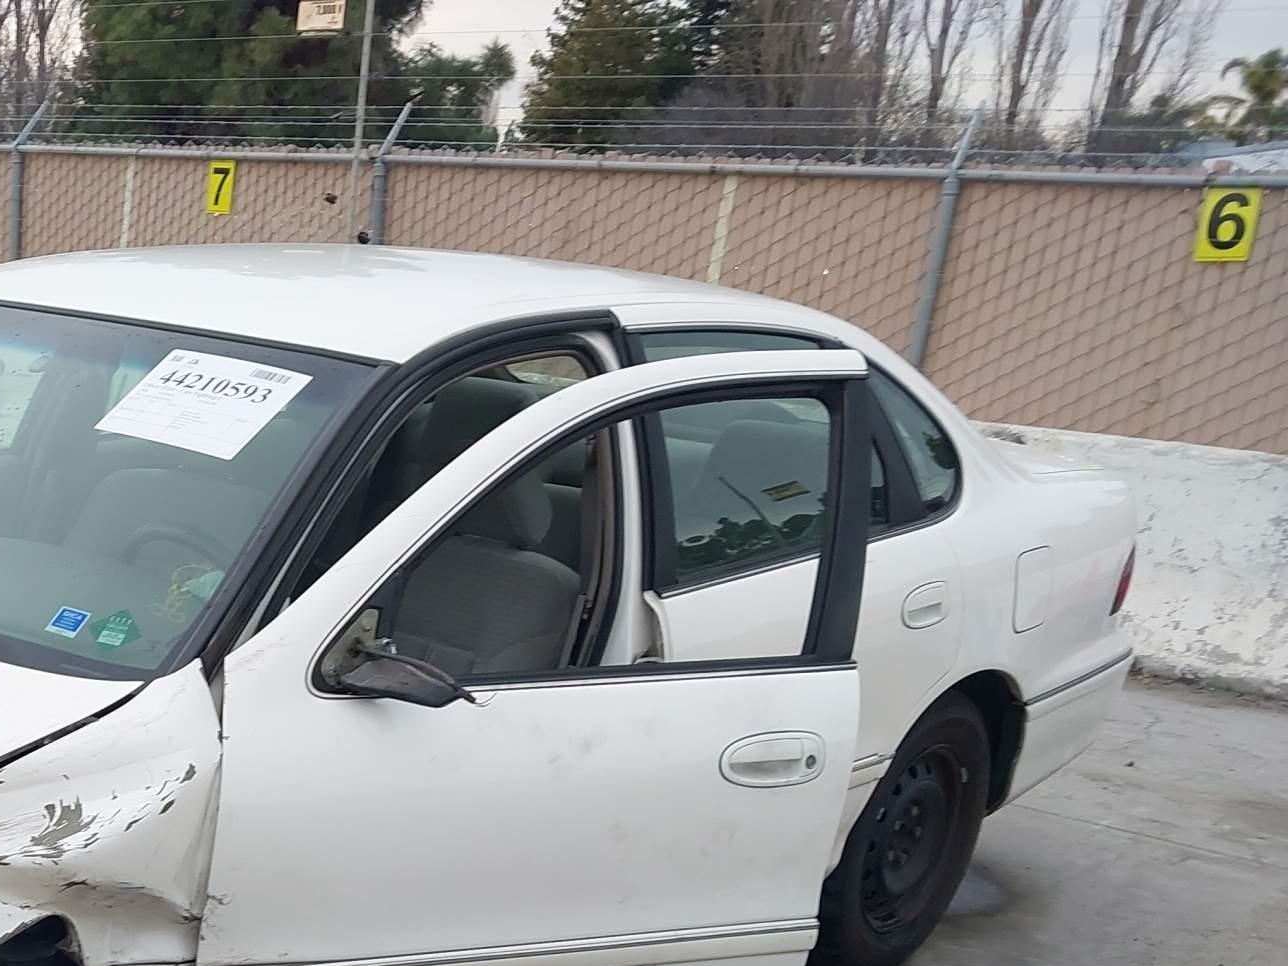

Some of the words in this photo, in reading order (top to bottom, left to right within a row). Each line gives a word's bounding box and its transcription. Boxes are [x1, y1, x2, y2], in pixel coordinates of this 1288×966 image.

[213, 167, 231, 206] 7
[1208, 192, 1250, 250] 6
[160, 369, 273, 404] 44210593
